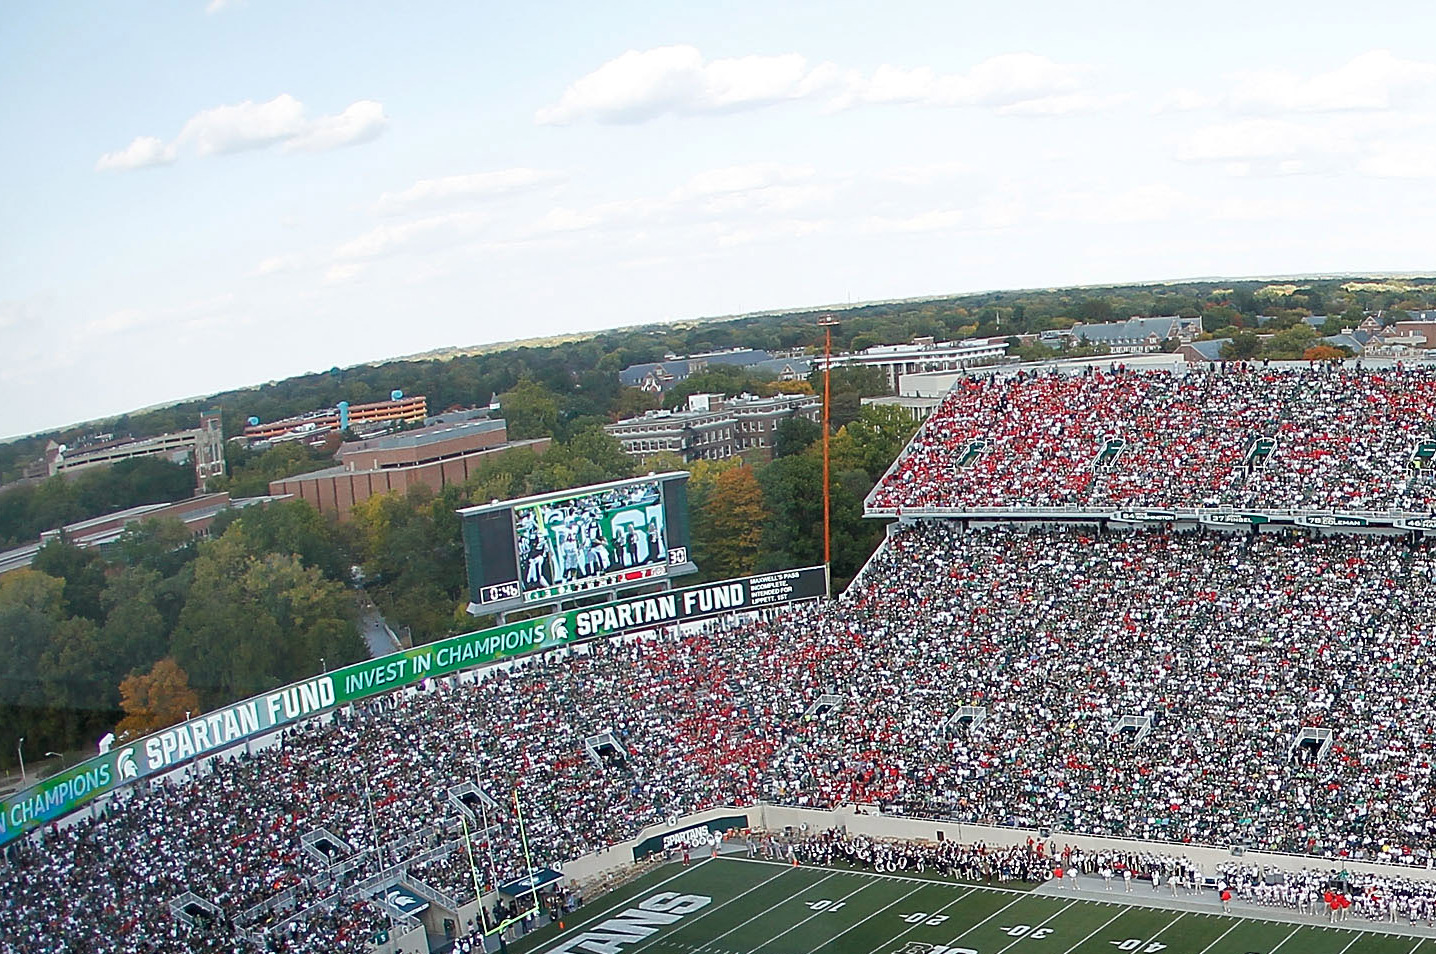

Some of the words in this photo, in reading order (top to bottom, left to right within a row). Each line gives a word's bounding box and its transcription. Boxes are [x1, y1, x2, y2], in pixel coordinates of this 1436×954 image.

[669, 550, 685, 564] 30
[577, 602, 676, 636] SPARTAN
[683, 583, 744, 615] FUND
[345, 660, 407, 694] INVEST
[412, 652, 432, 675] IN
[436, 624, 546, 668] CHAMPIONS
[145, 701, 260, 771] SPARTAN
[267, 675, 336, 725] FUND
[10, 763, 111, 828] CHAMPIONS
[663, 825, 709, 848] SPARTANS
[906, 912, 950, 926] 20
[1006, 925, 1054, 939] 30
[1117, 938, 1168, 954] 40
